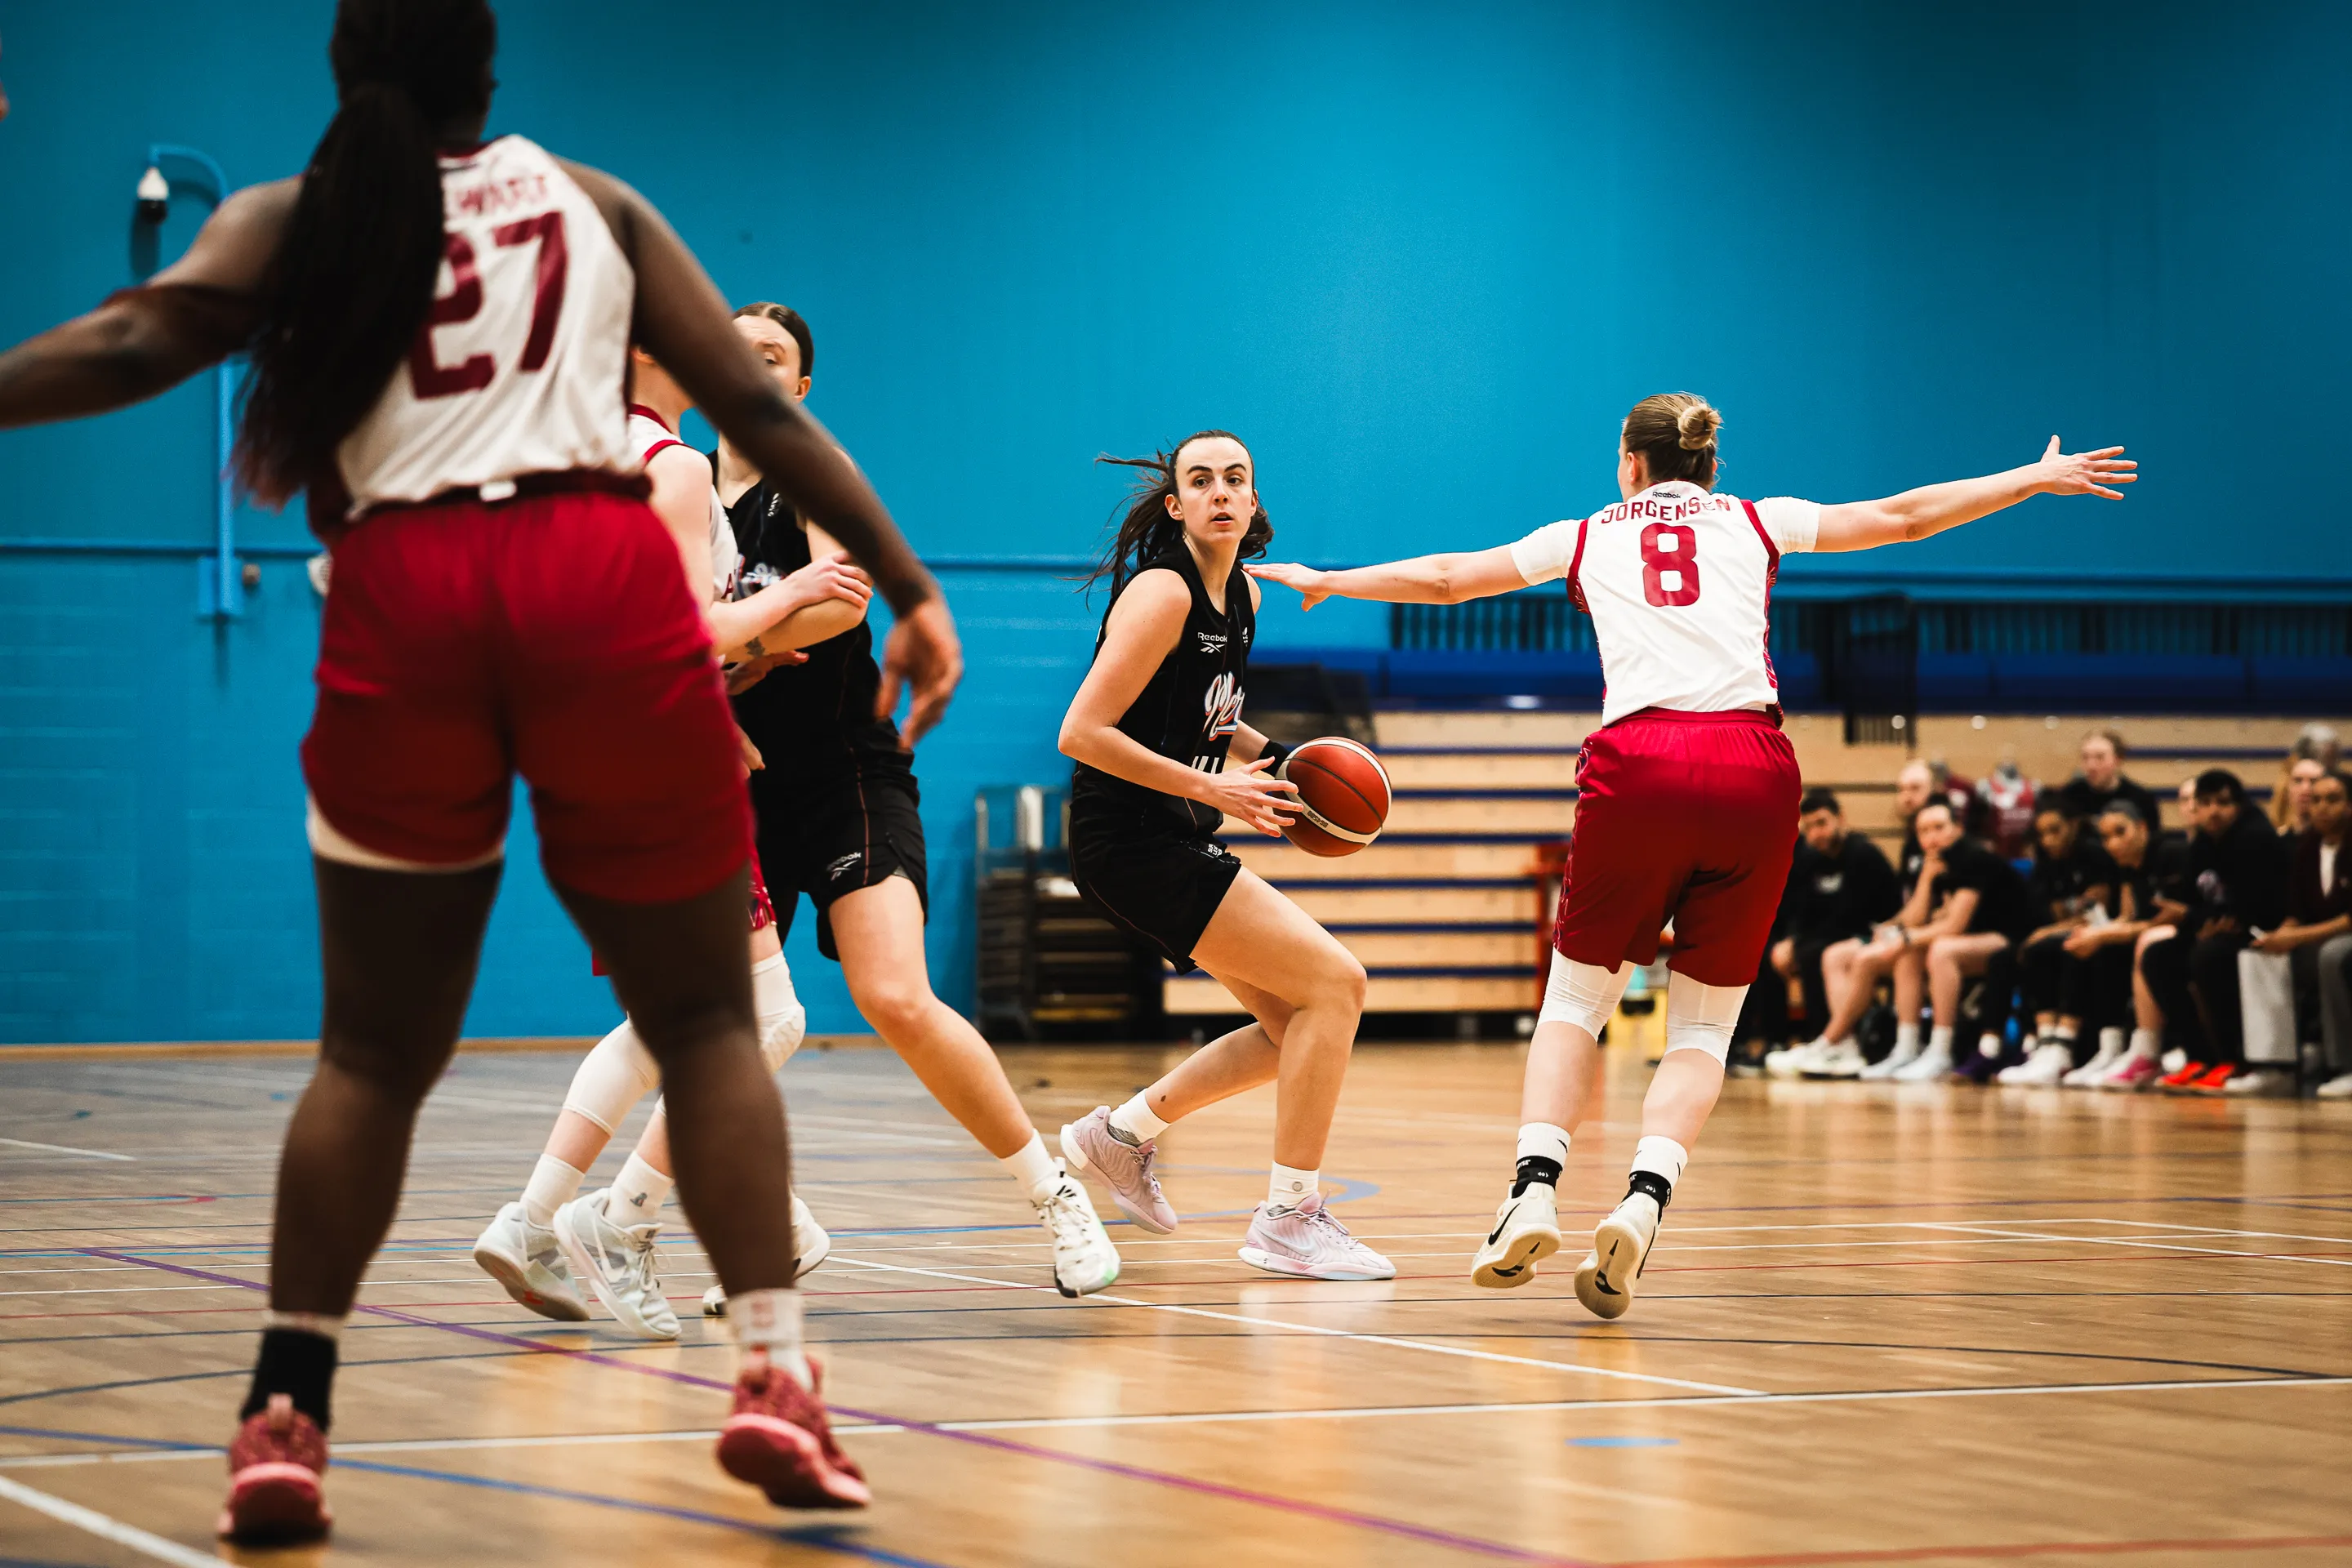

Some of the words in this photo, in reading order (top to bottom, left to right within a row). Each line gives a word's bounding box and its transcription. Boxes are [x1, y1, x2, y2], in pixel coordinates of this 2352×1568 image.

[410, 209, 569, 402] 27
[1652, 491, 1681, 499] Reebok
[1601, 497, 1731, 524] JORGENSEN
[1641, 522, 1700, 608] 8
[1197, 631, 1227, 643] Reebok
